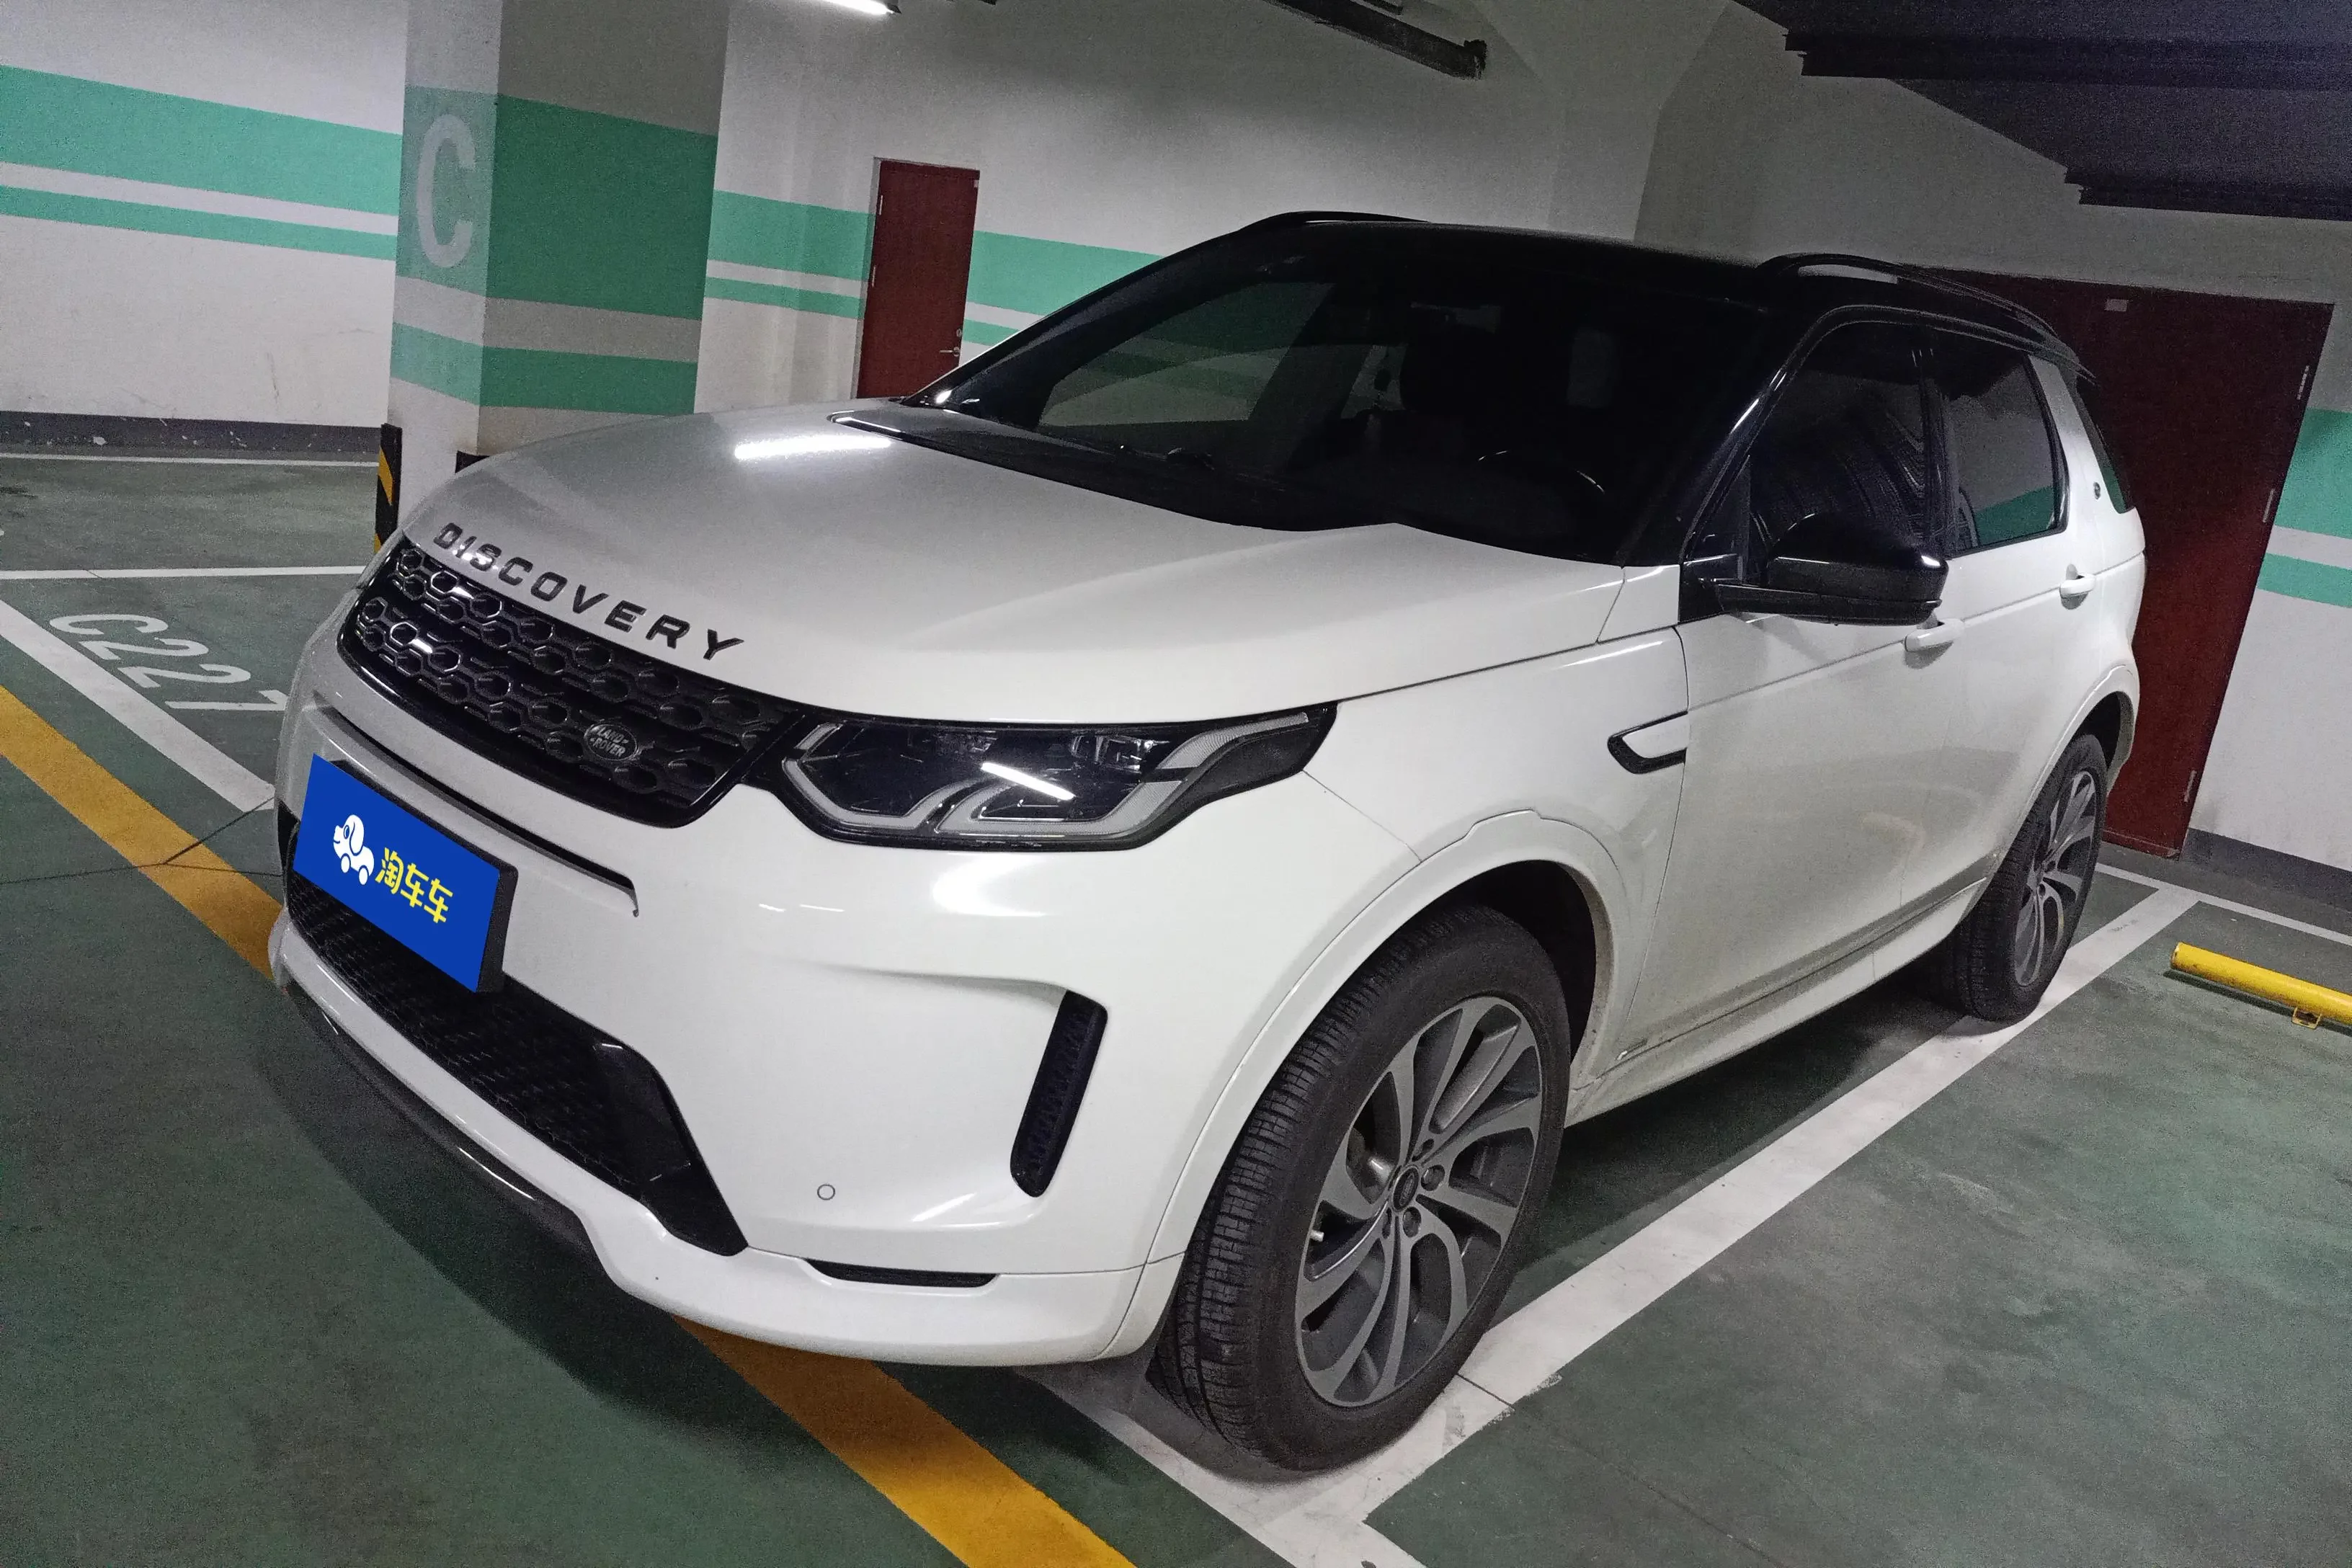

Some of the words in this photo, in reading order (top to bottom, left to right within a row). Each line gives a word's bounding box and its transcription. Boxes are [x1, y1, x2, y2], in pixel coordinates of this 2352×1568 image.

[416, 114, 475, 267] C
[434, 522, 744, 660] DISCOVERY
[49, 614, 288, 711] C221
